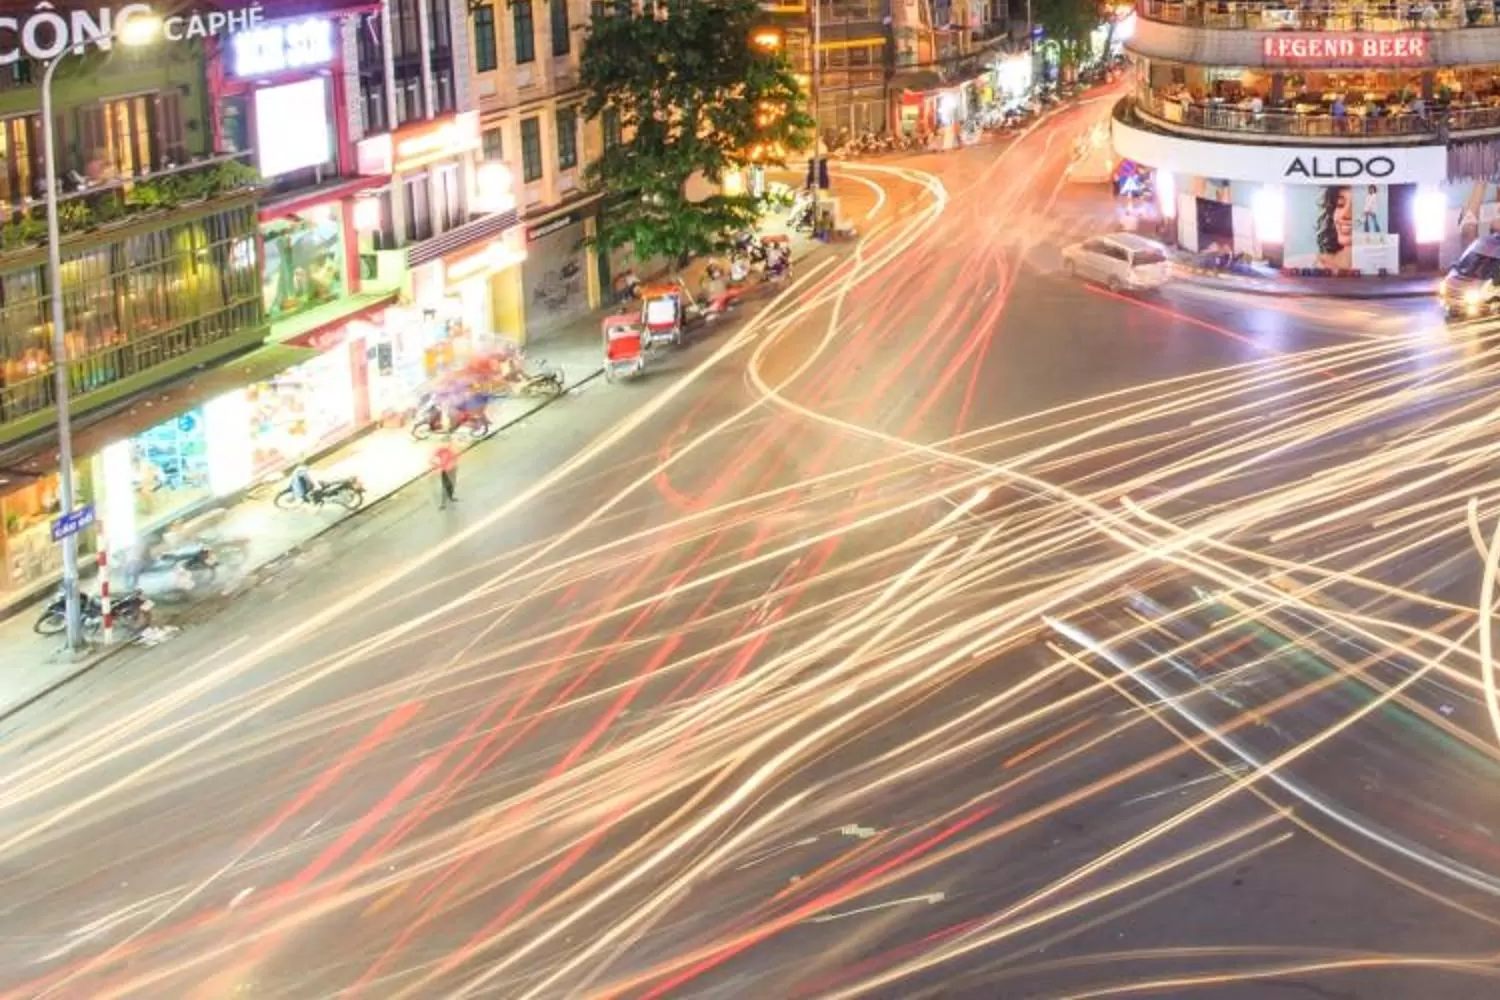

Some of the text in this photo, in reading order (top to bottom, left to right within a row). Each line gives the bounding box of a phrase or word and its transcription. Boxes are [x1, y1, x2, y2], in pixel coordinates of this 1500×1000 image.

[1264, 37, 1424, 57] LEGEND BEER
[1283, 156, 1395, 178] ALDO
